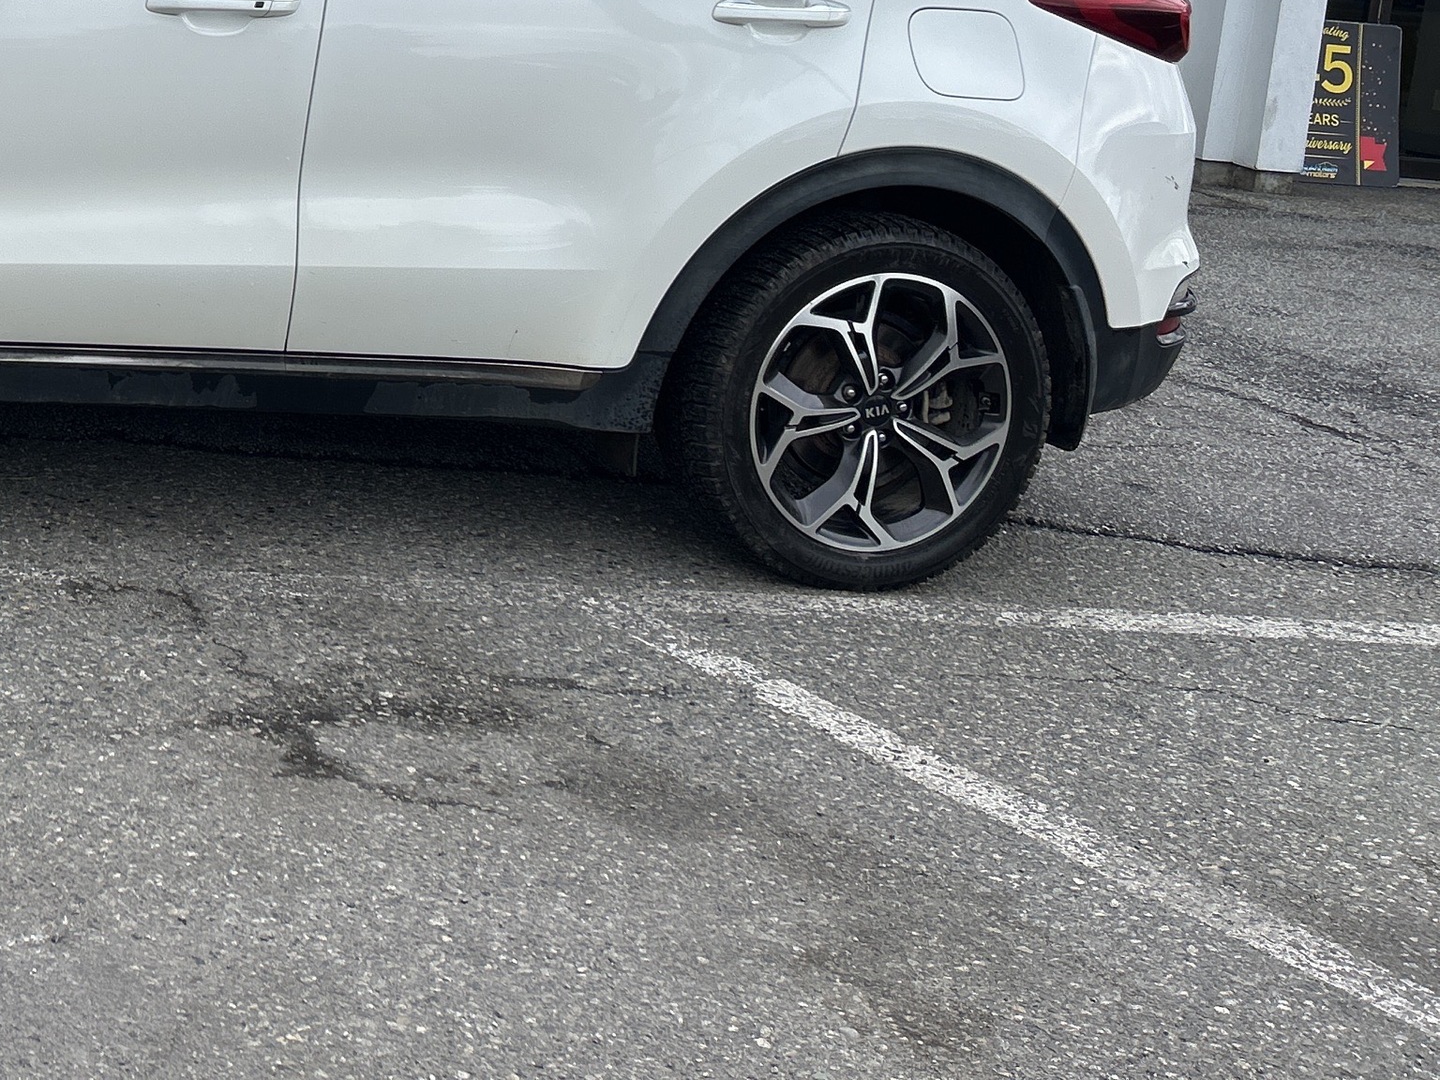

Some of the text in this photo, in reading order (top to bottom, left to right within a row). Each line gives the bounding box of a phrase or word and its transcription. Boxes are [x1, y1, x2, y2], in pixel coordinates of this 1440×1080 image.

[1322, 26, 1350, 41] ating
[1315, 44, 1353, 94] 5
[1306, 136, 1353, 155] niversary
[865, 404, 890, 419] KIA
